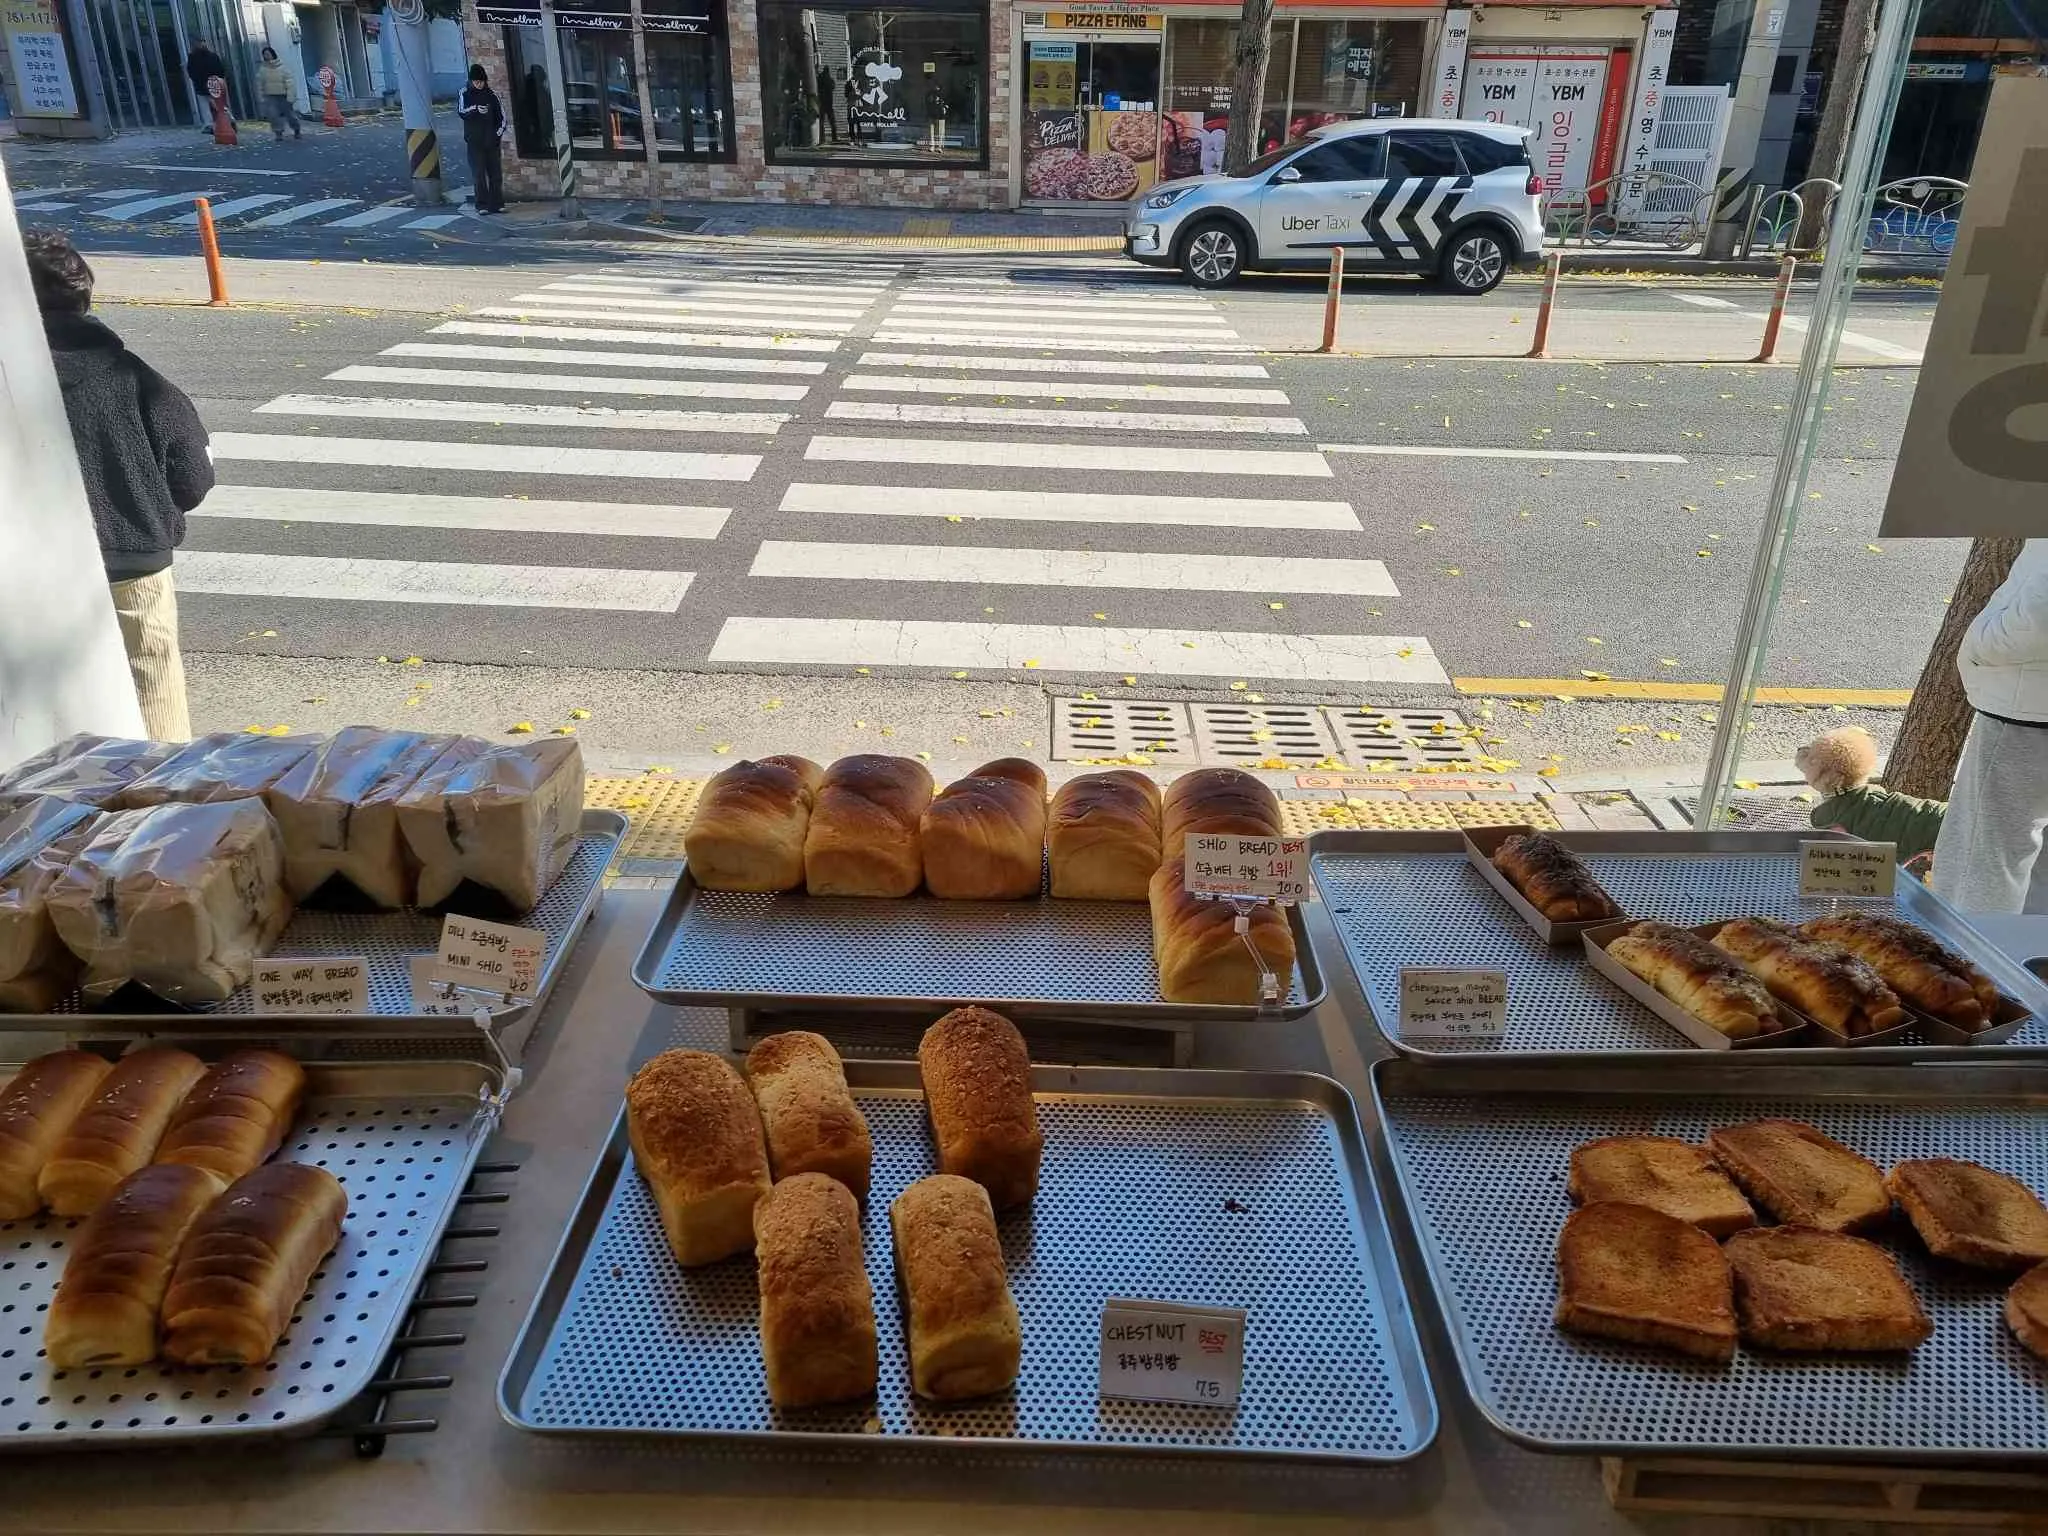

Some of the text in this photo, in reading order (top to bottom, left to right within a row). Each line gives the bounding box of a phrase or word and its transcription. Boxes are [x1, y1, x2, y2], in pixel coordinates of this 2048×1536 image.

[1065, 14, 1148, 28] PIZZA ETANG
[1448, 28, 1466, 38] YBM
[1654, 29, 1672, 38] YBM
[1348, 48, 1373, 60] 피자
[1347, 60, 1371, 76] 에땅
[1482, 84, 1516, 100] YBM
[1551, 85, 1585, 101] YBM
[1044, 131, 1079, 146] DELIVER
[1281, 214, 1351, 231] Uber Taxi
[1197, 838, 1305, 856] SHIO BREAD BEST
[1195, 859, 1294, 881] 소금버터 식빵 1위!
[447, 925, 512, 953] 미니 소금식빵
[447, 953, 471, 967] MINI
[476, 959, 503, 975] SHIO
[260, 966, 360, 983] ONE WAY BREAD
[1106, 1323, 1228, 1346] CHESTNUT BEST
